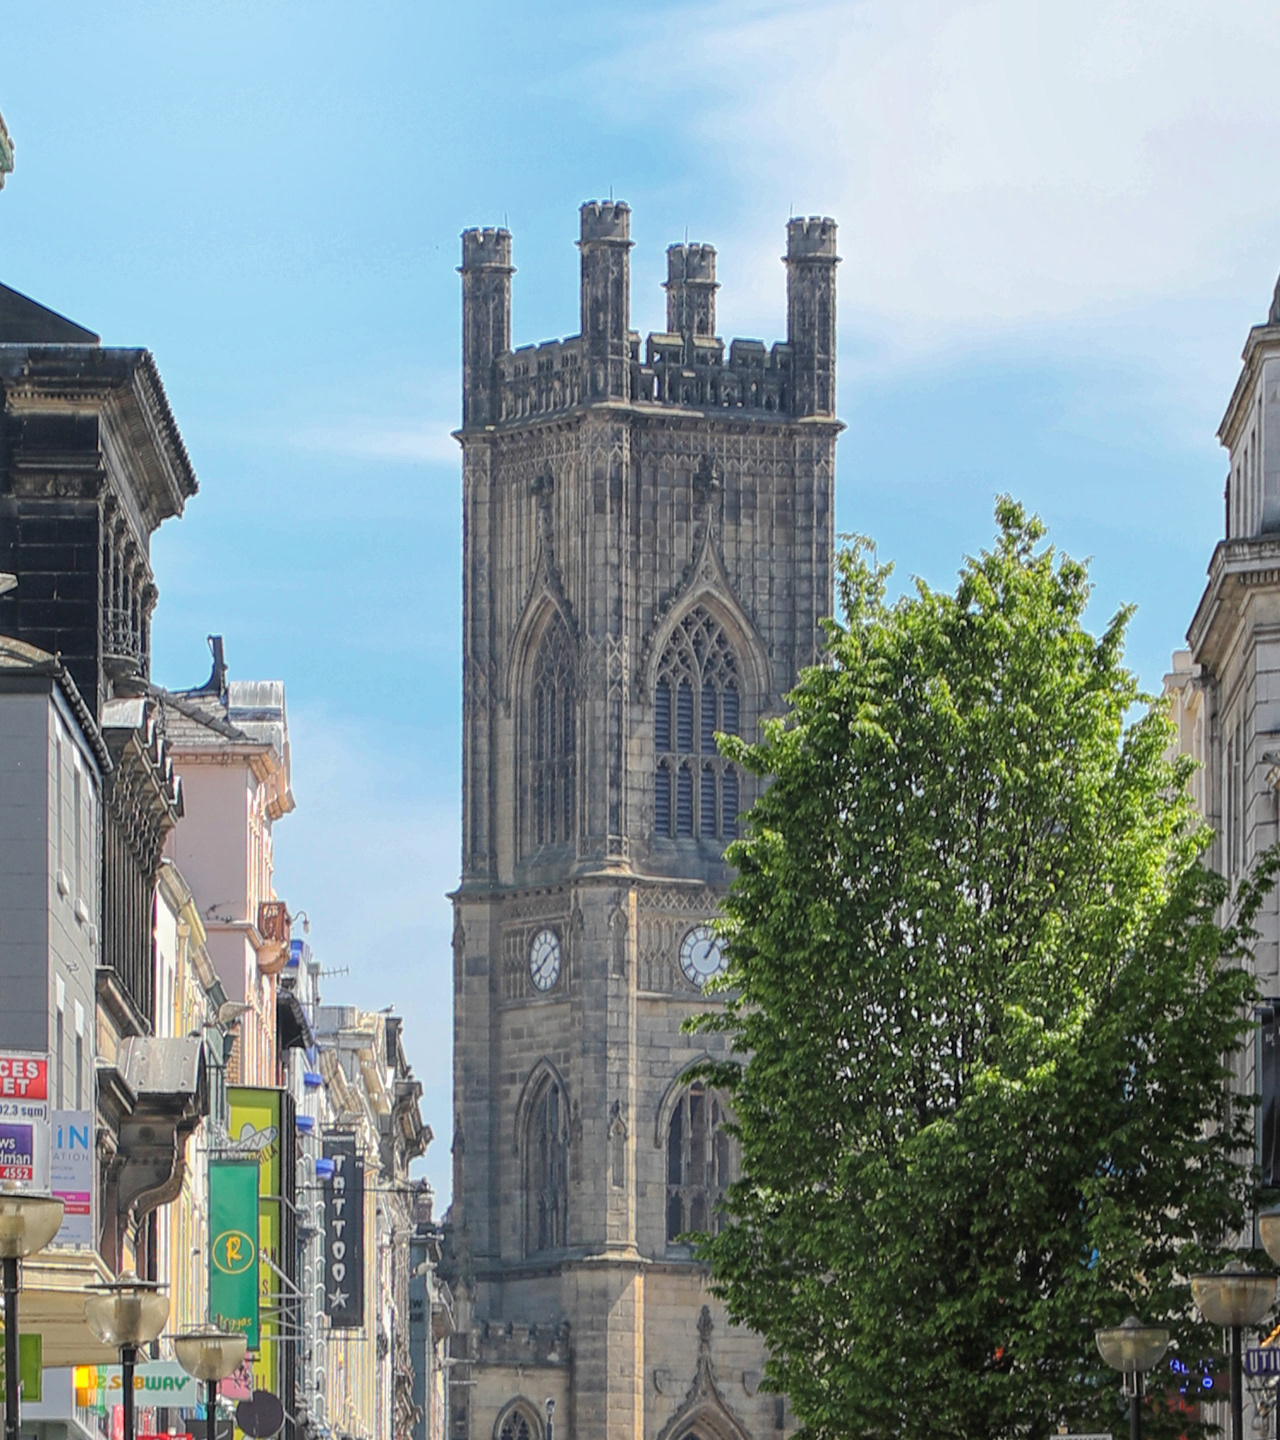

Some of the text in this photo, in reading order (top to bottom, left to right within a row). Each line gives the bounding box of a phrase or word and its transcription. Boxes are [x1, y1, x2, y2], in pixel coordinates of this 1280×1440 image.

[21, 1105, 48, 1120] sqm)
[3, 1167, 29, 1179] 4552
[331, 1154, 346, 1282] TATTOO
[109, 1376, 190, 1391] SBWAY
